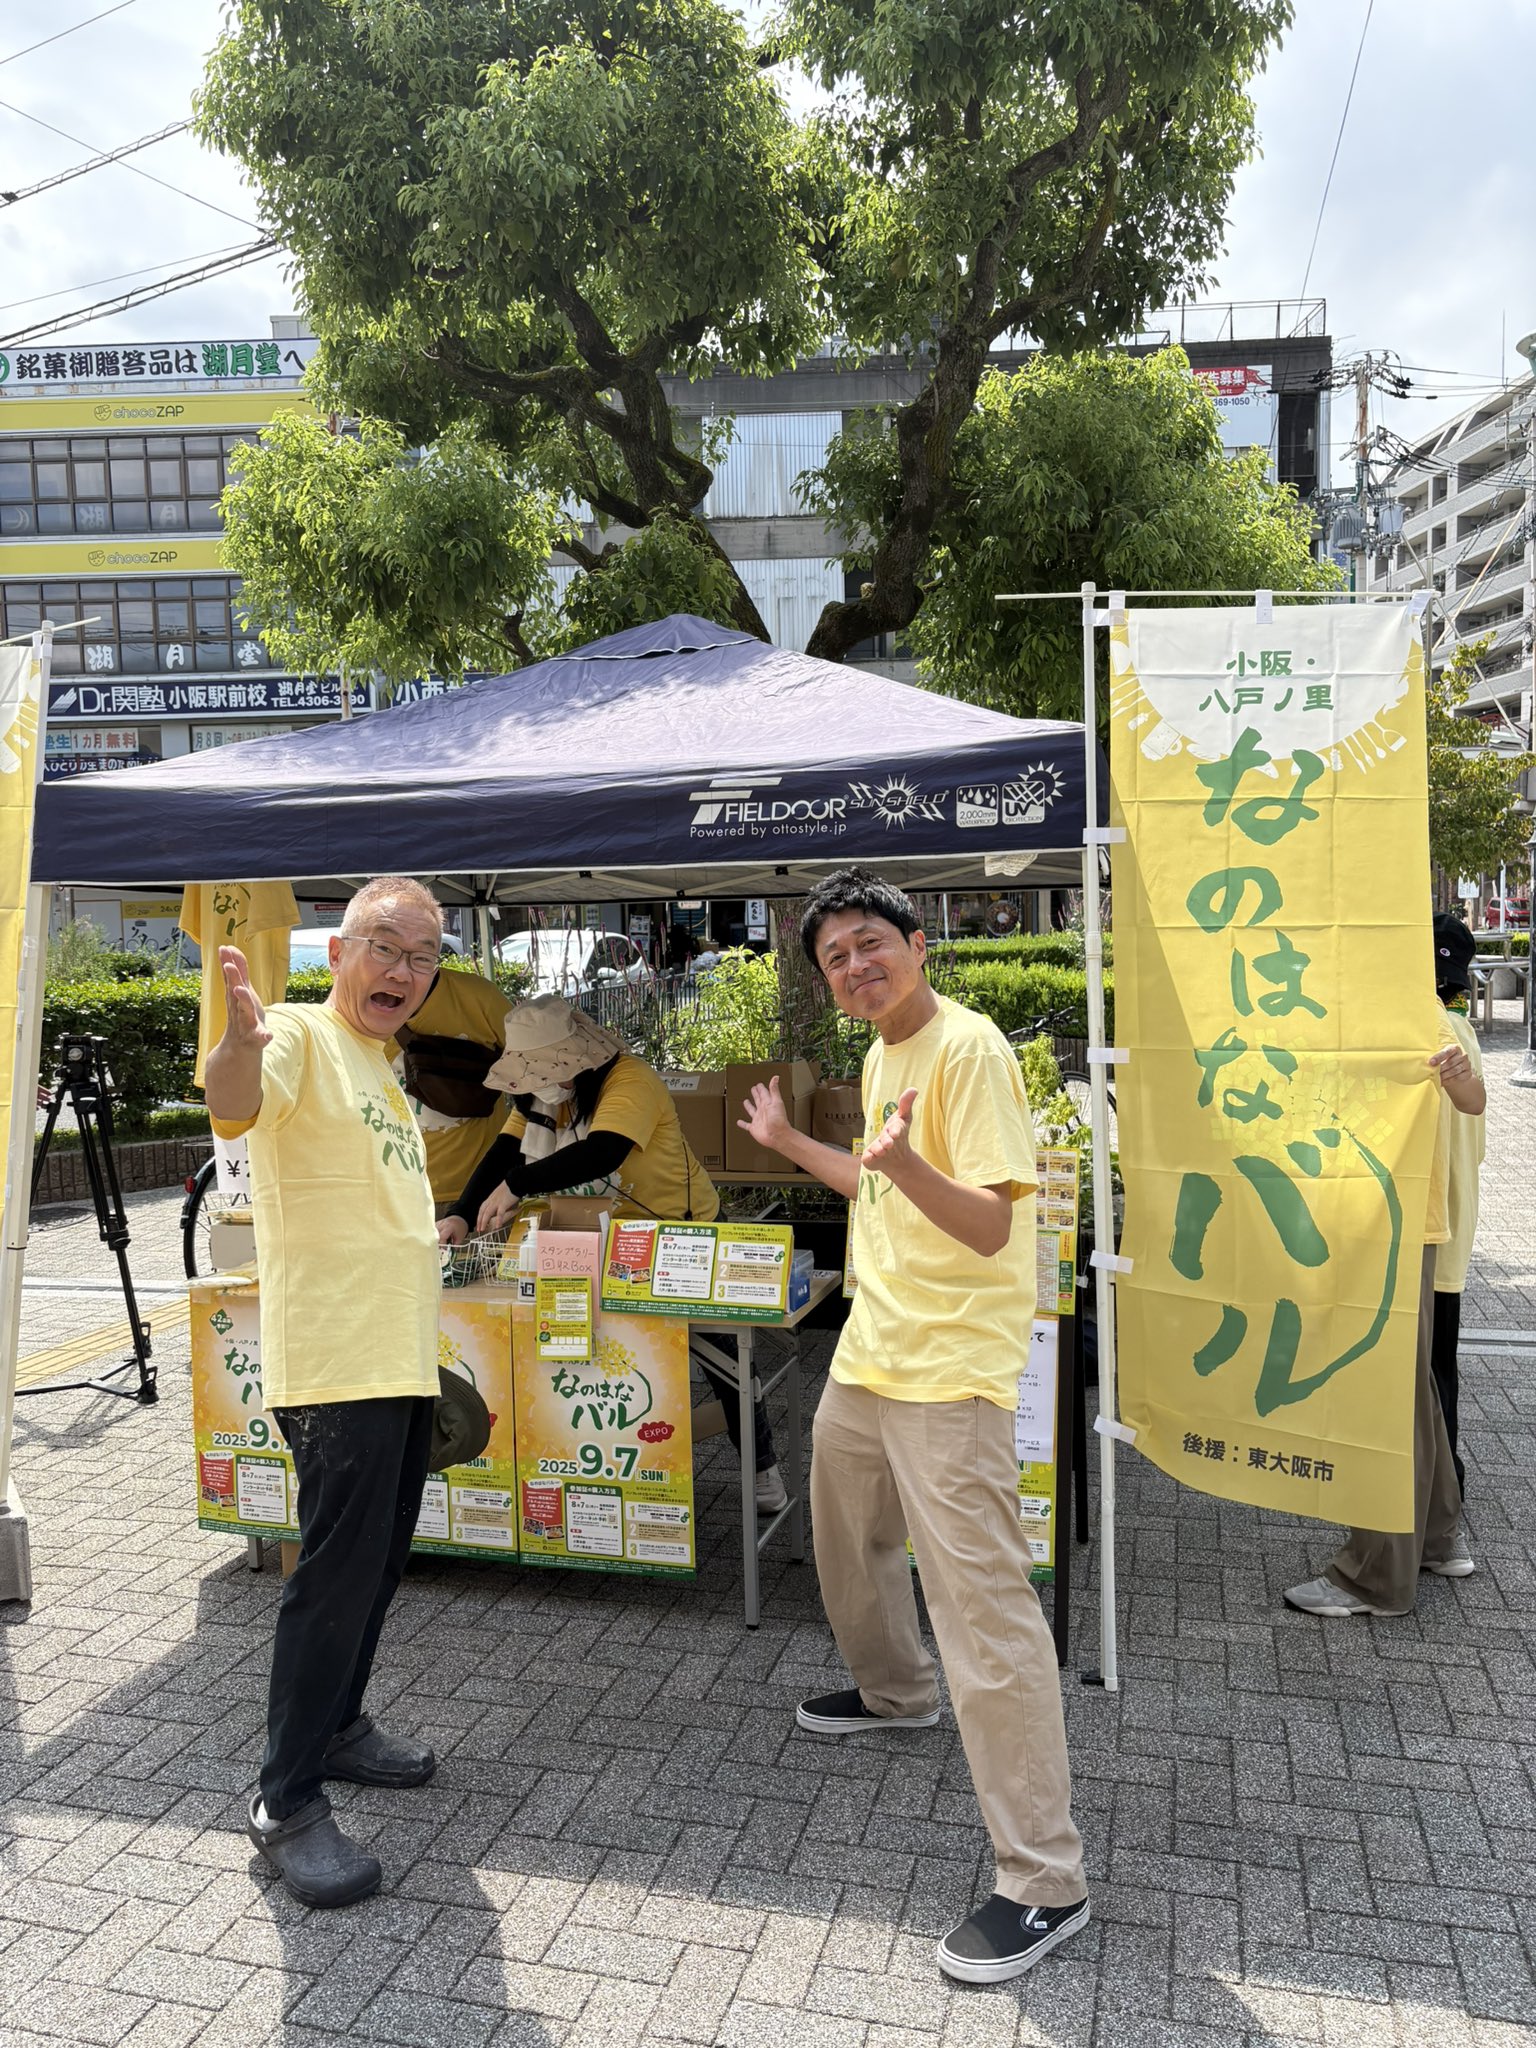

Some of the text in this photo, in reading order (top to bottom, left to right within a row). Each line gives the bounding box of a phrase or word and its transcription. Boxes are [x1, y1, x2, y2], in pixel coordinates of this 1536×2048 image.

[113, 405, 185, 419] chocoZAP
[106, 550, 178, 564] chocoZAP
[271, 694, 365, 708] TEL.4306-390
[1199, 685, 1335, 714] 八戸ノ里
[725, 798, 846, 823] FIELDOOR
[960, 810, 996, 820] 2,000mm
[1005, 802, 1031, 816] UV
[690, 822, 847, 839] Powered by ottostyle.jp
[723, 1246, 729, 1258] 1
[720, 1264, 727, 1277] 2
[718, 1285, 725, 1298] 3
[551, 1368, 635, 1402] なのはな
[213, 1432, 248, 1446] 2025
[644, 1426, 669, 1439] EXPO
[540, 1460, 578, 1475] 2025
[579, 1444, 639, 1478] 9.7
[630, 1523, 637, 1536] 2
[630, 1543, 637, 1556] 3
